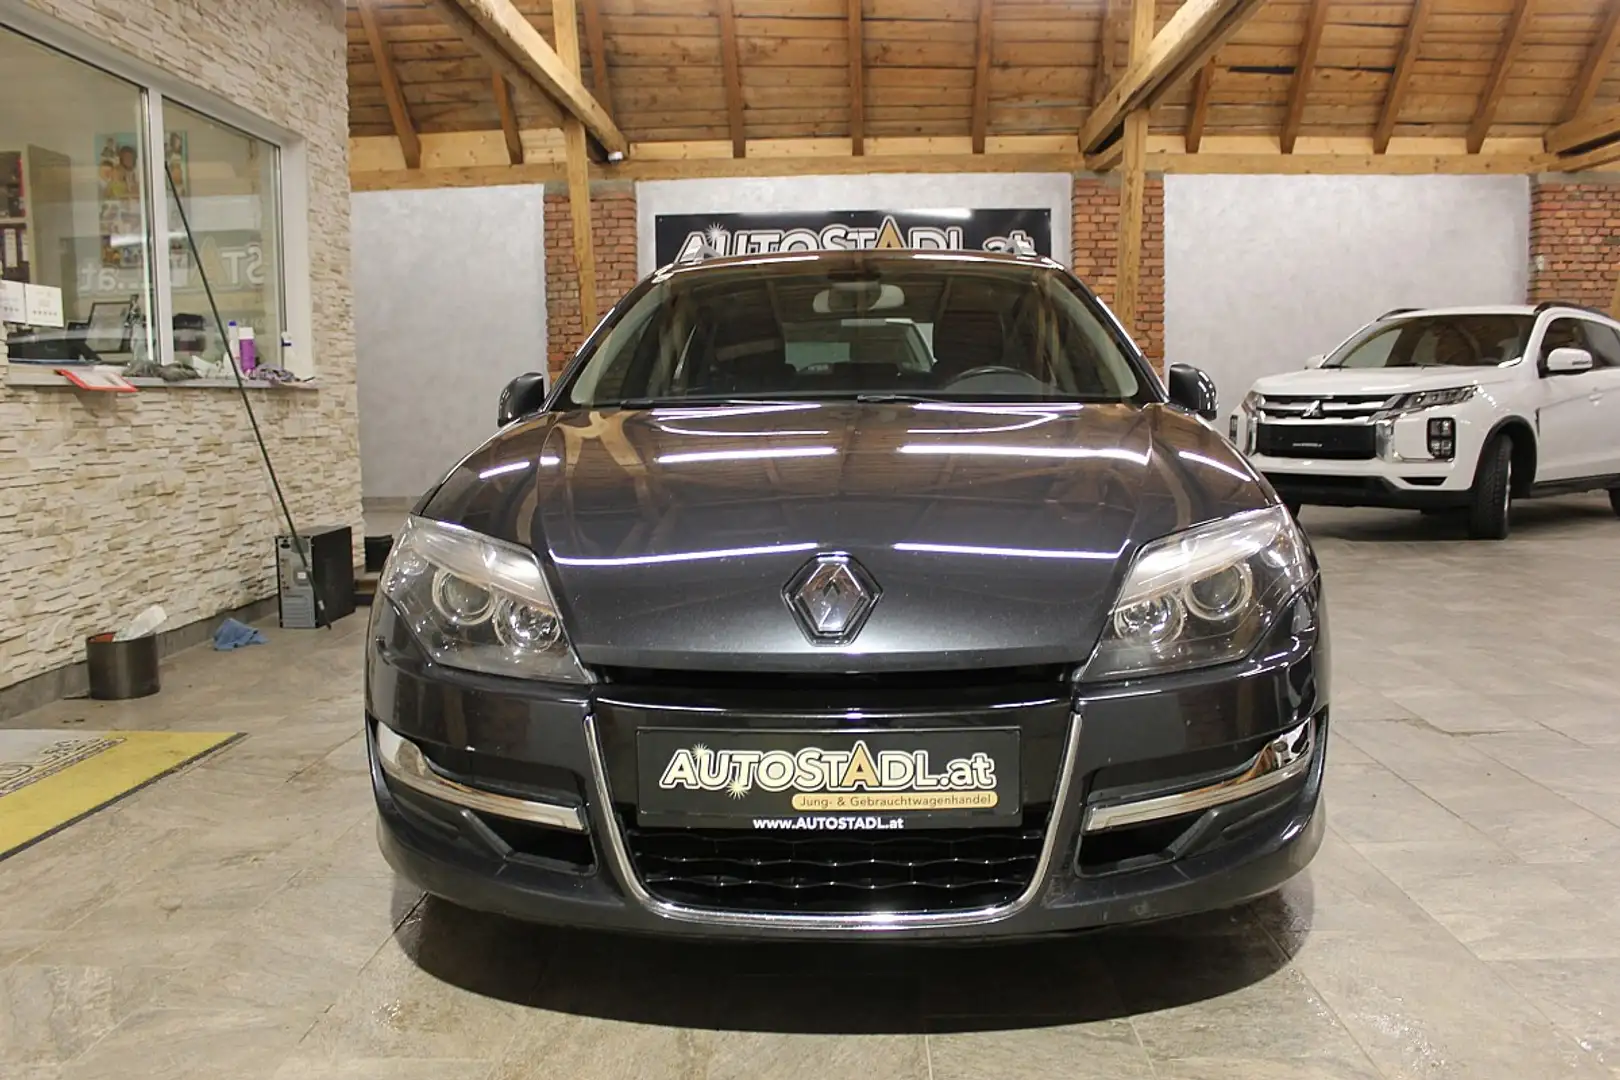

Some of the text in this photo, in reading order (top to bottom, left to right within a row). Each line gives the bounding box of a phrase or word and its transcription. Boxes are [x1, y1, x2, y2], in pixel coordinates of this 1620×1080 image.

[659, 740, 997, 793] AUTOSTADL.at
[800, 793, 991, 808] Jung- & Gebrauchtwagenhandel
[753, 816, 904, 830] www.AUTOSTADL.at
